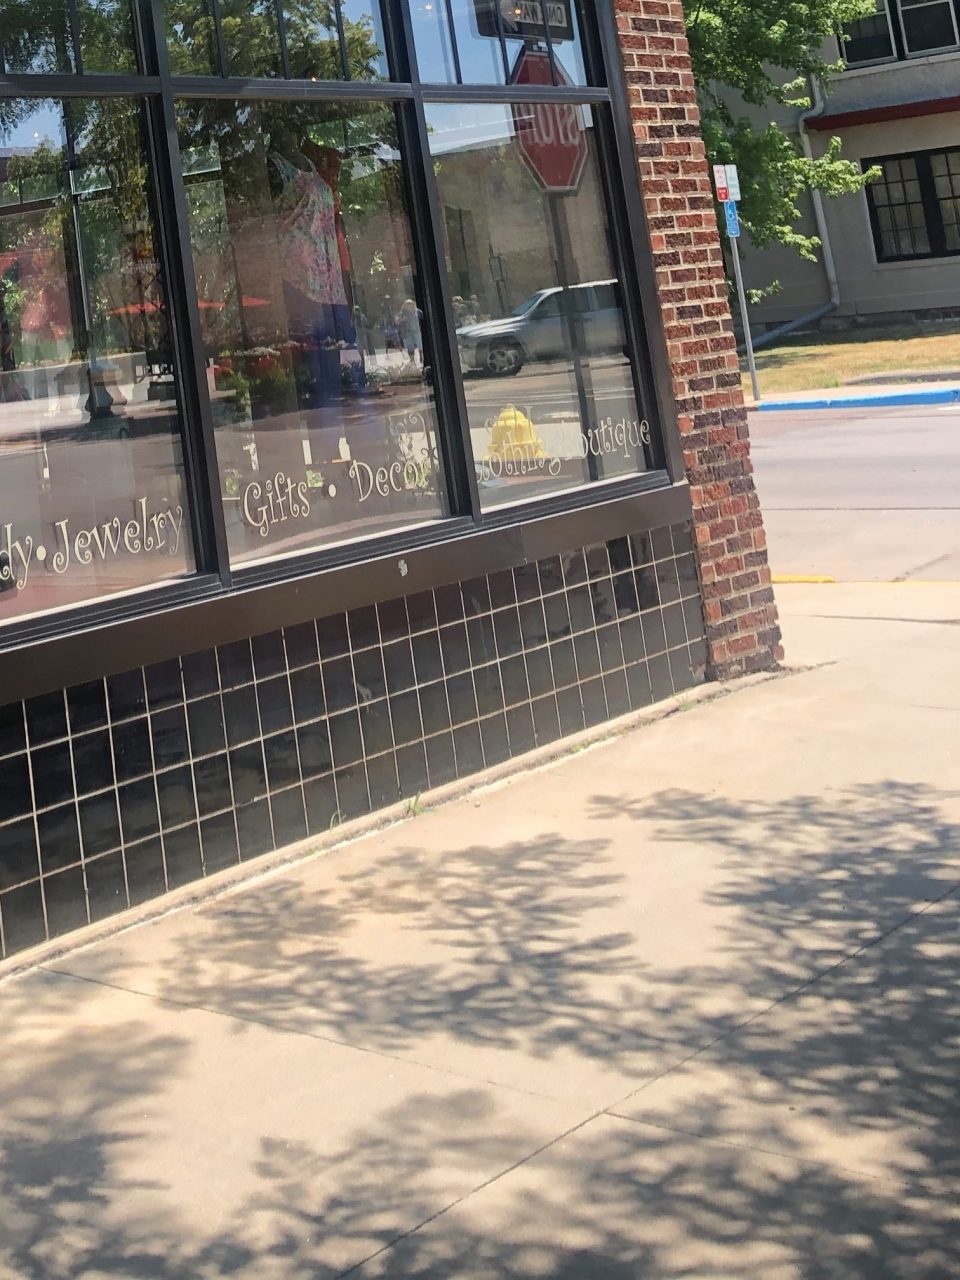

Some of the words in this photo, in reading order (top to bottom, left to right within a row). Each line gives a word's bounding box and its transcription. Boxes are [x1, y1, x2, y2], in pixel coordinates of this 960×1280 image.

[561, 416, 651, 461] outique
[52, 496, 184, 574] Jewelry
[243, 471, 310, 537] Gifts
